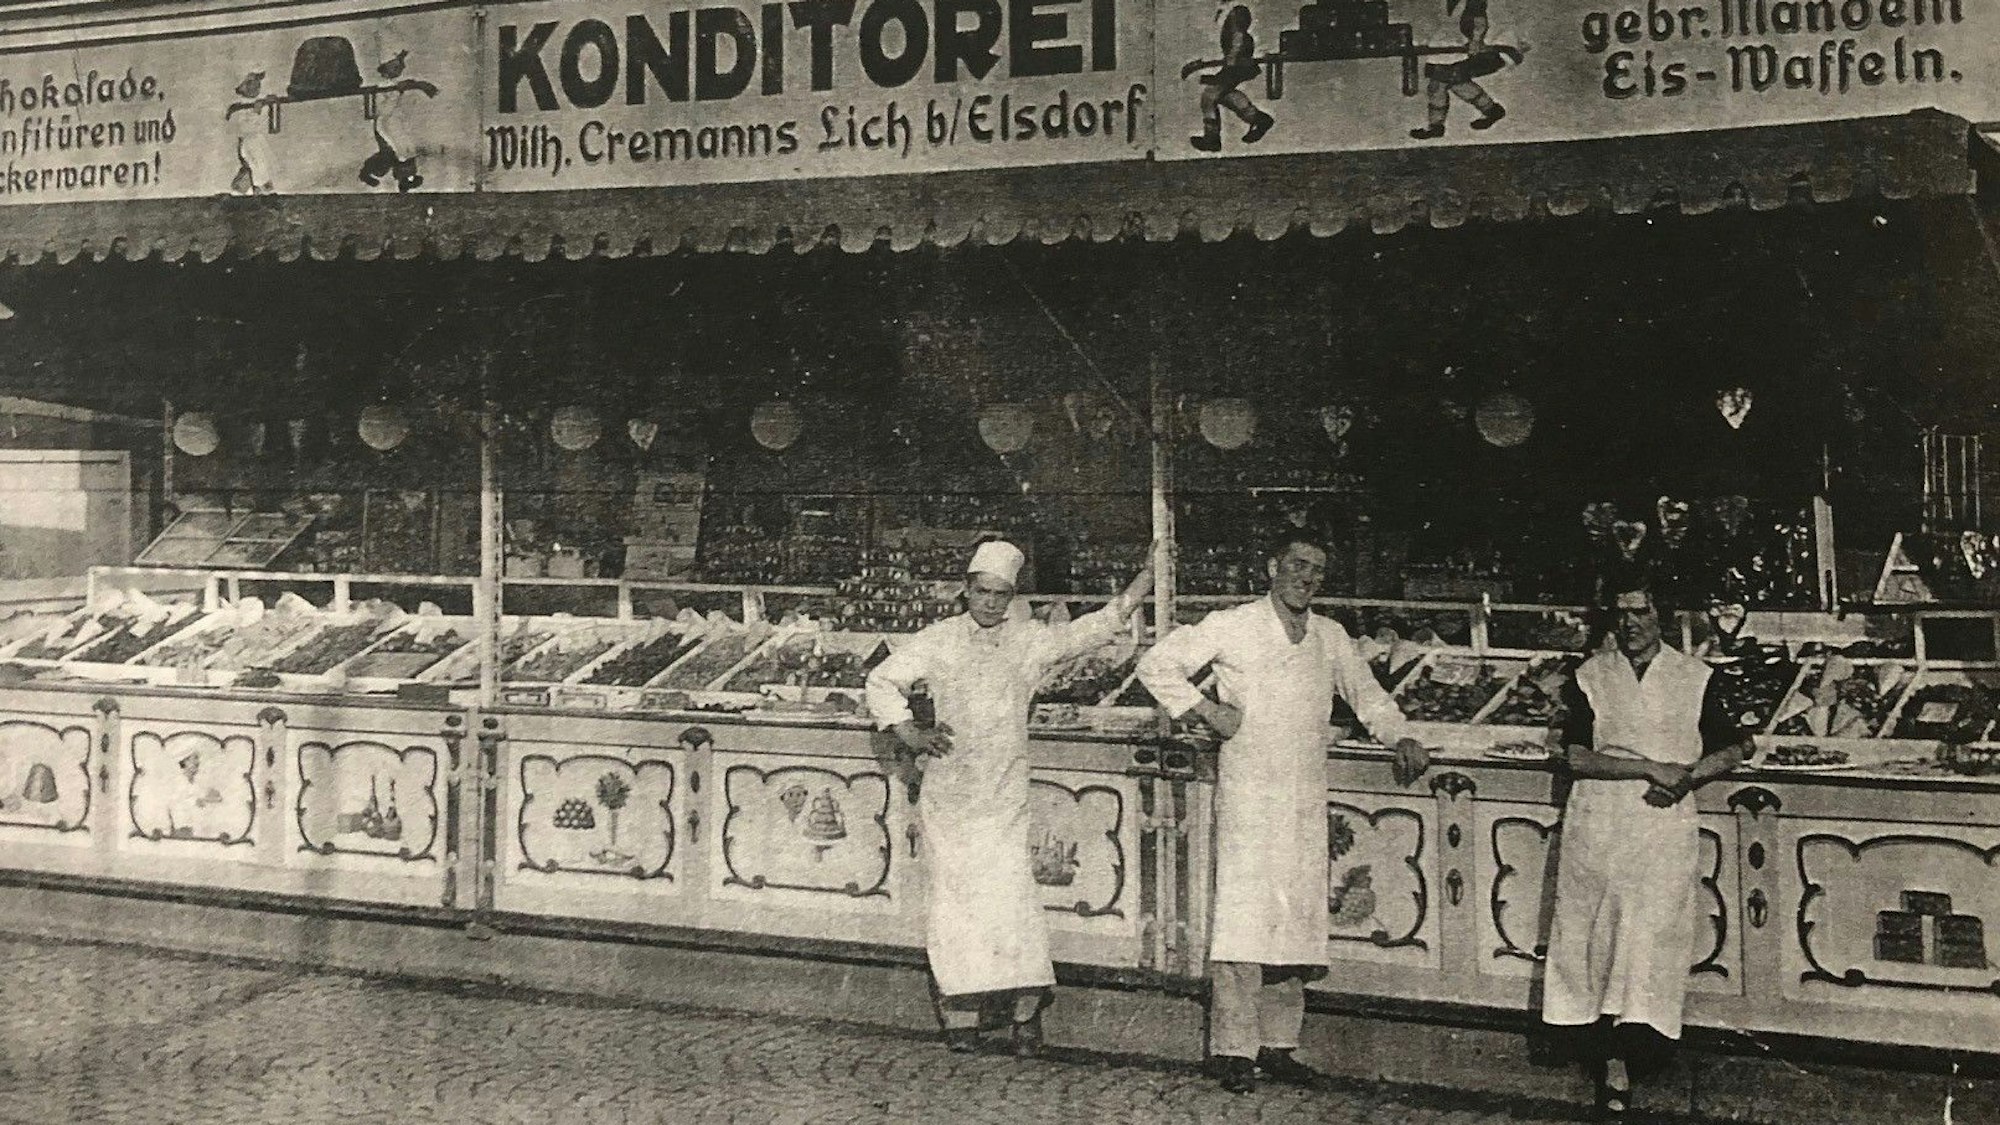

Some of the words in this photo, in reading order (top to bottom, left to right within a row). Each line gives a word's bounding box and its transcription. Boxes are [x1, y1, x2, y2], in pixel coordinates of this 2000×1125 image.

[498, 0, 1117, 113] KONDITOREI
[1581, 0, 1711, 53] gebr.
[134, 108, 177, 145] und
[485, 123, 572, 177] Wilh.
[578, 120, 799, 163] Cremanns
[817, 100, 910, 159] Lich
